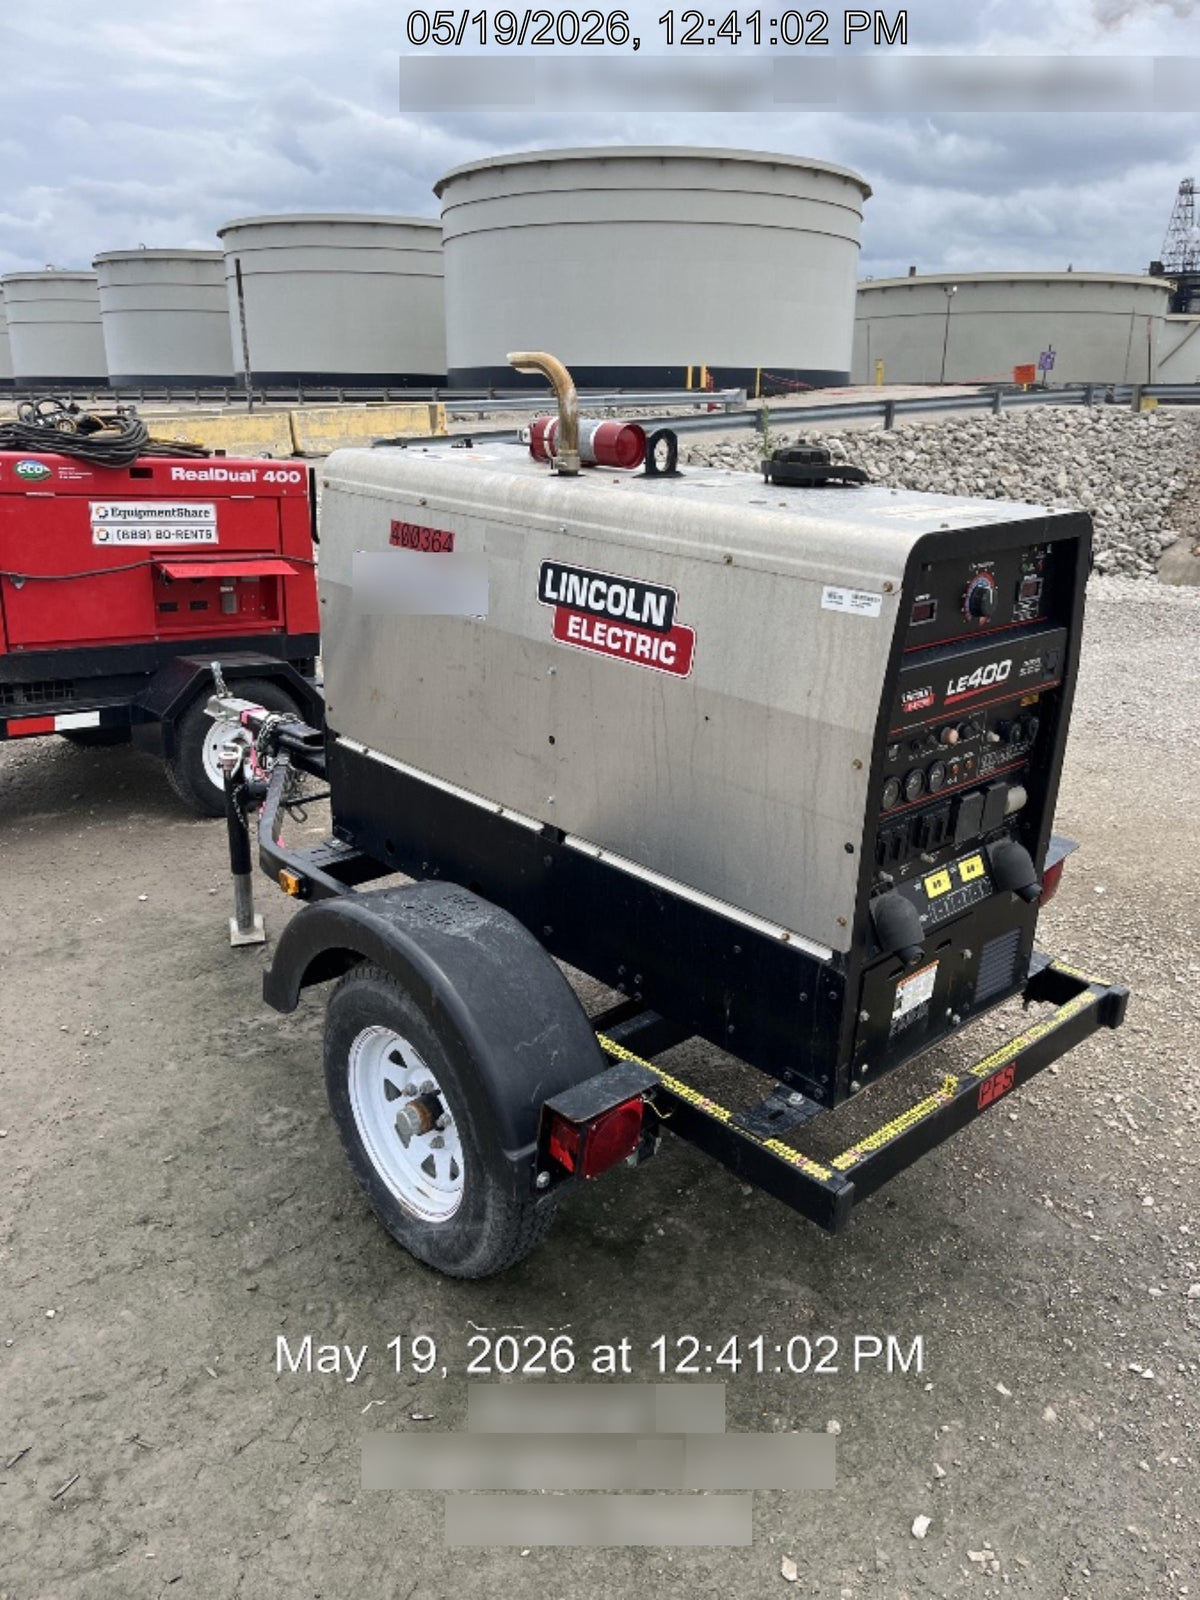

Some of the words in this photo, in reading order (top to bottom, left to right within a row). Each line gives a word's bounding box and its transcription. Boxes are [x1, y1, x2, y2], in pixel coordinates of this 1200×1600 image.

[171, 467, 257, 482] RealDual
[262, 470, 301, 483] 400
[111, 507, 211, 519] EquipmentShare
[116, 529, 152, 540] (888)
[391, 520, 454, 553] 400364
[544, 567, 668, 628] LINCOLN
[566, 615, 678, 666] ELECTRIC
[945, 659, 1013, 696] LE400
